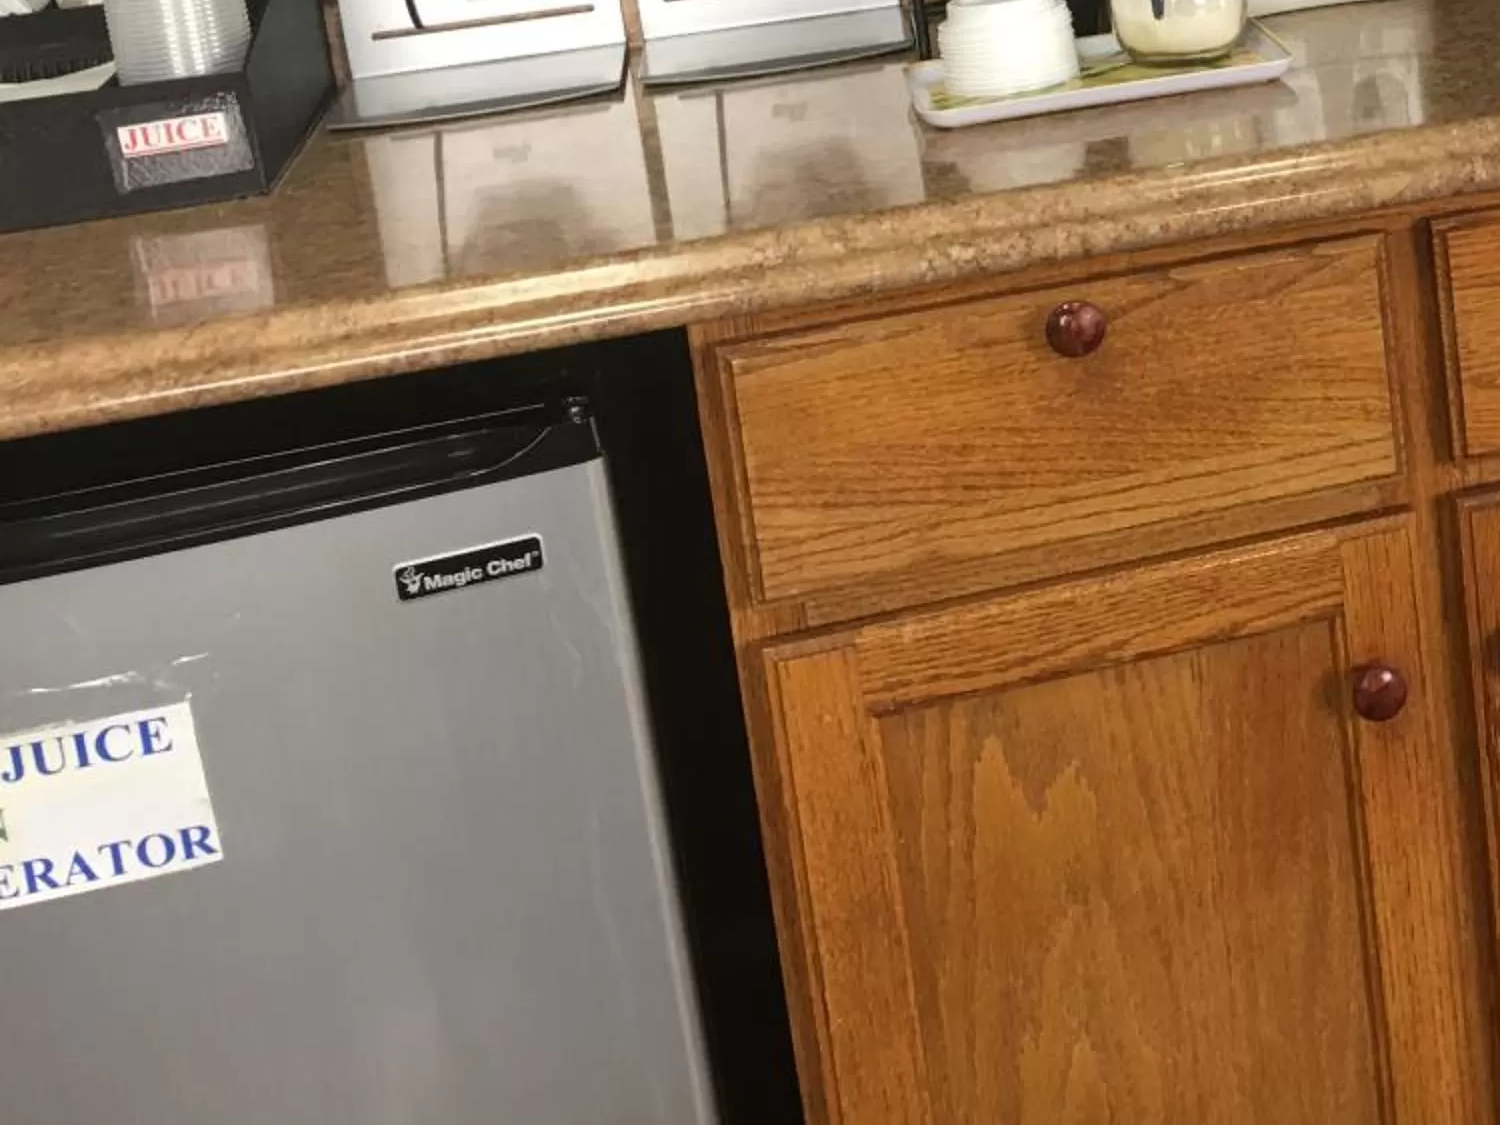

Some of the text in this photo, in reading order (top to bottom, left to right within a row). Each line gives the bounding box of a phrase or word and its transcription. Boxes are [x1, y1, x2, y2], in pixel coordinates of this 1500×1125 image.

[124, 117, 222, 151] JUICE
[423, 566, 483, 591] Magic
[2, 716, 173, 783] JUICE
